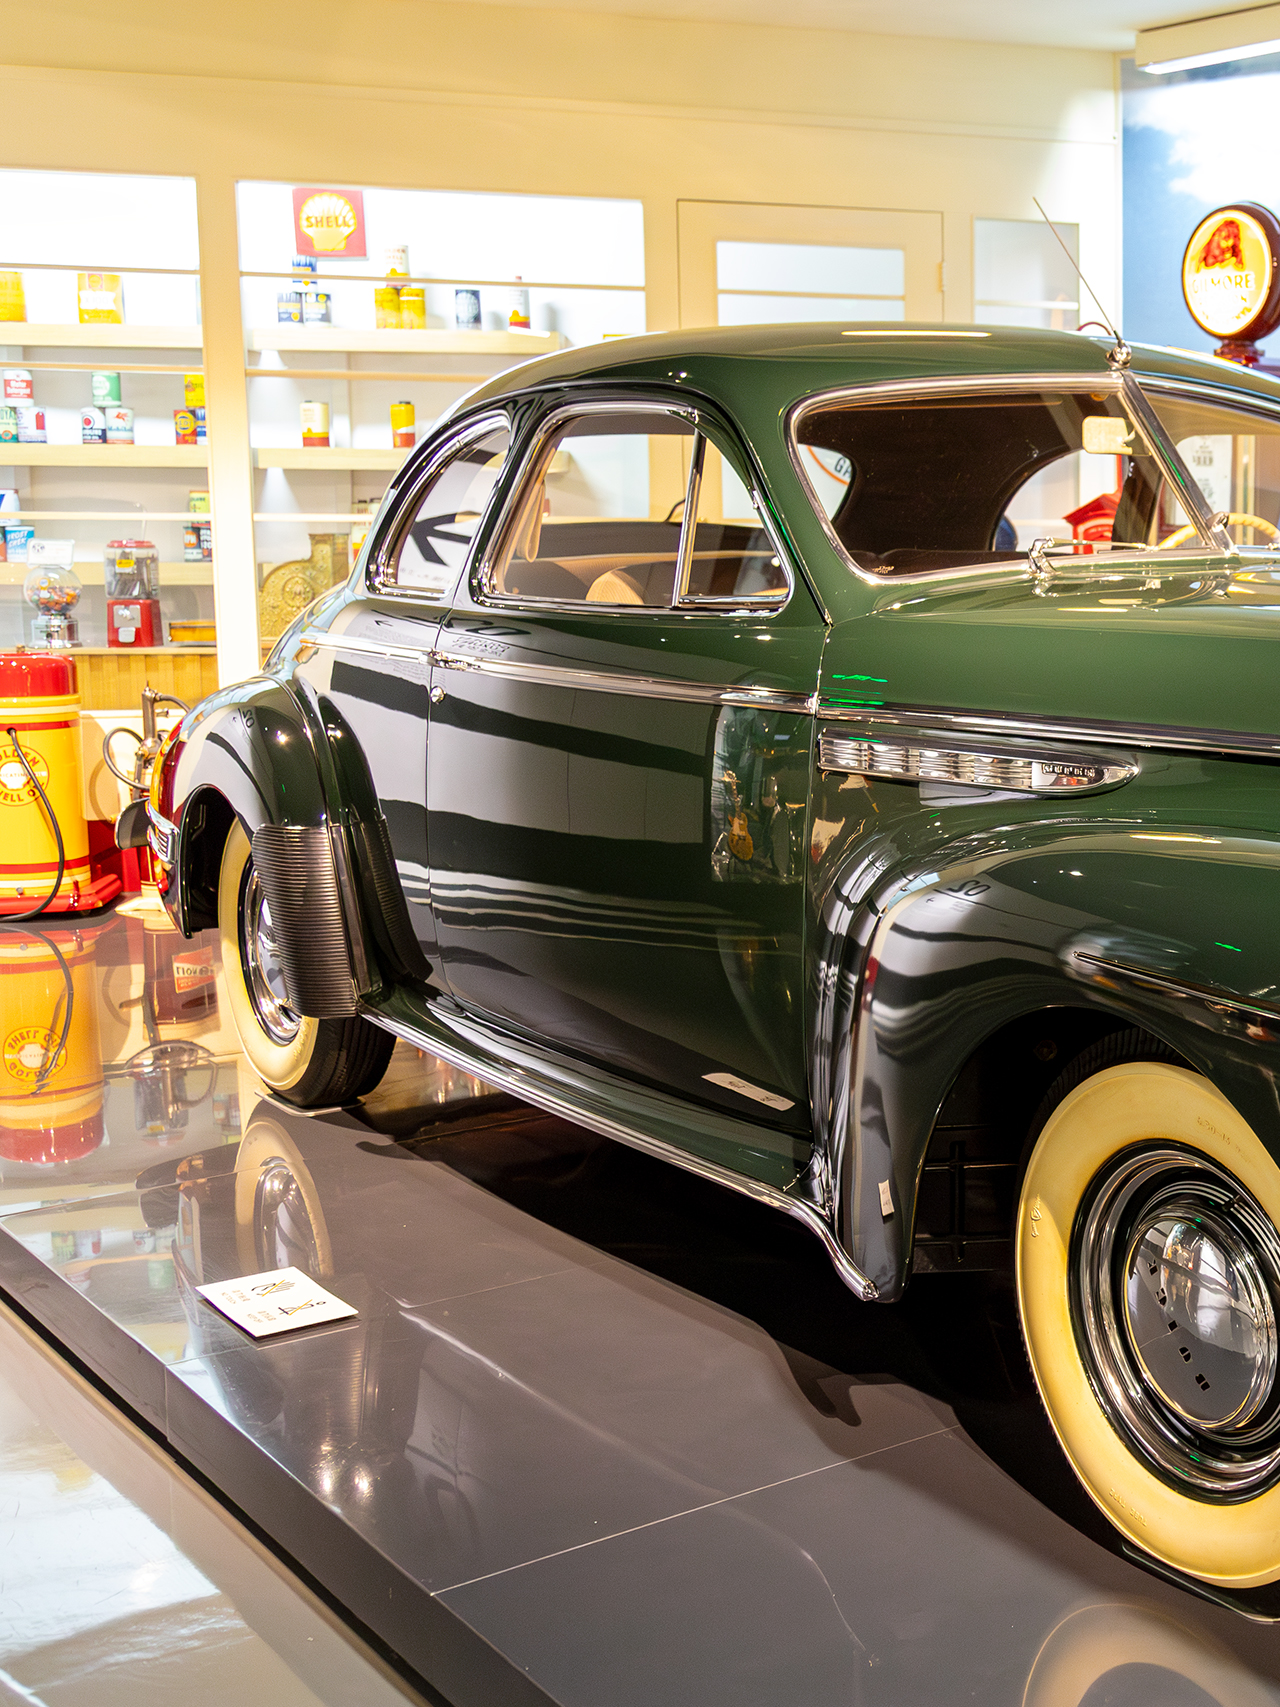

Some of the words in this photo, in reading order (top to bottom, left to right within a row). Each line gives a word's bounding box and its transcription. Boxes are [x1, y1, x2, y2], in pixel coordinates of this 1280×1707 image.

[305, 215, 351, 228] SHELL
[1193, 273, 1253, 294] GILMORE
[1147, 1259, 1211, 1392] BUICK
